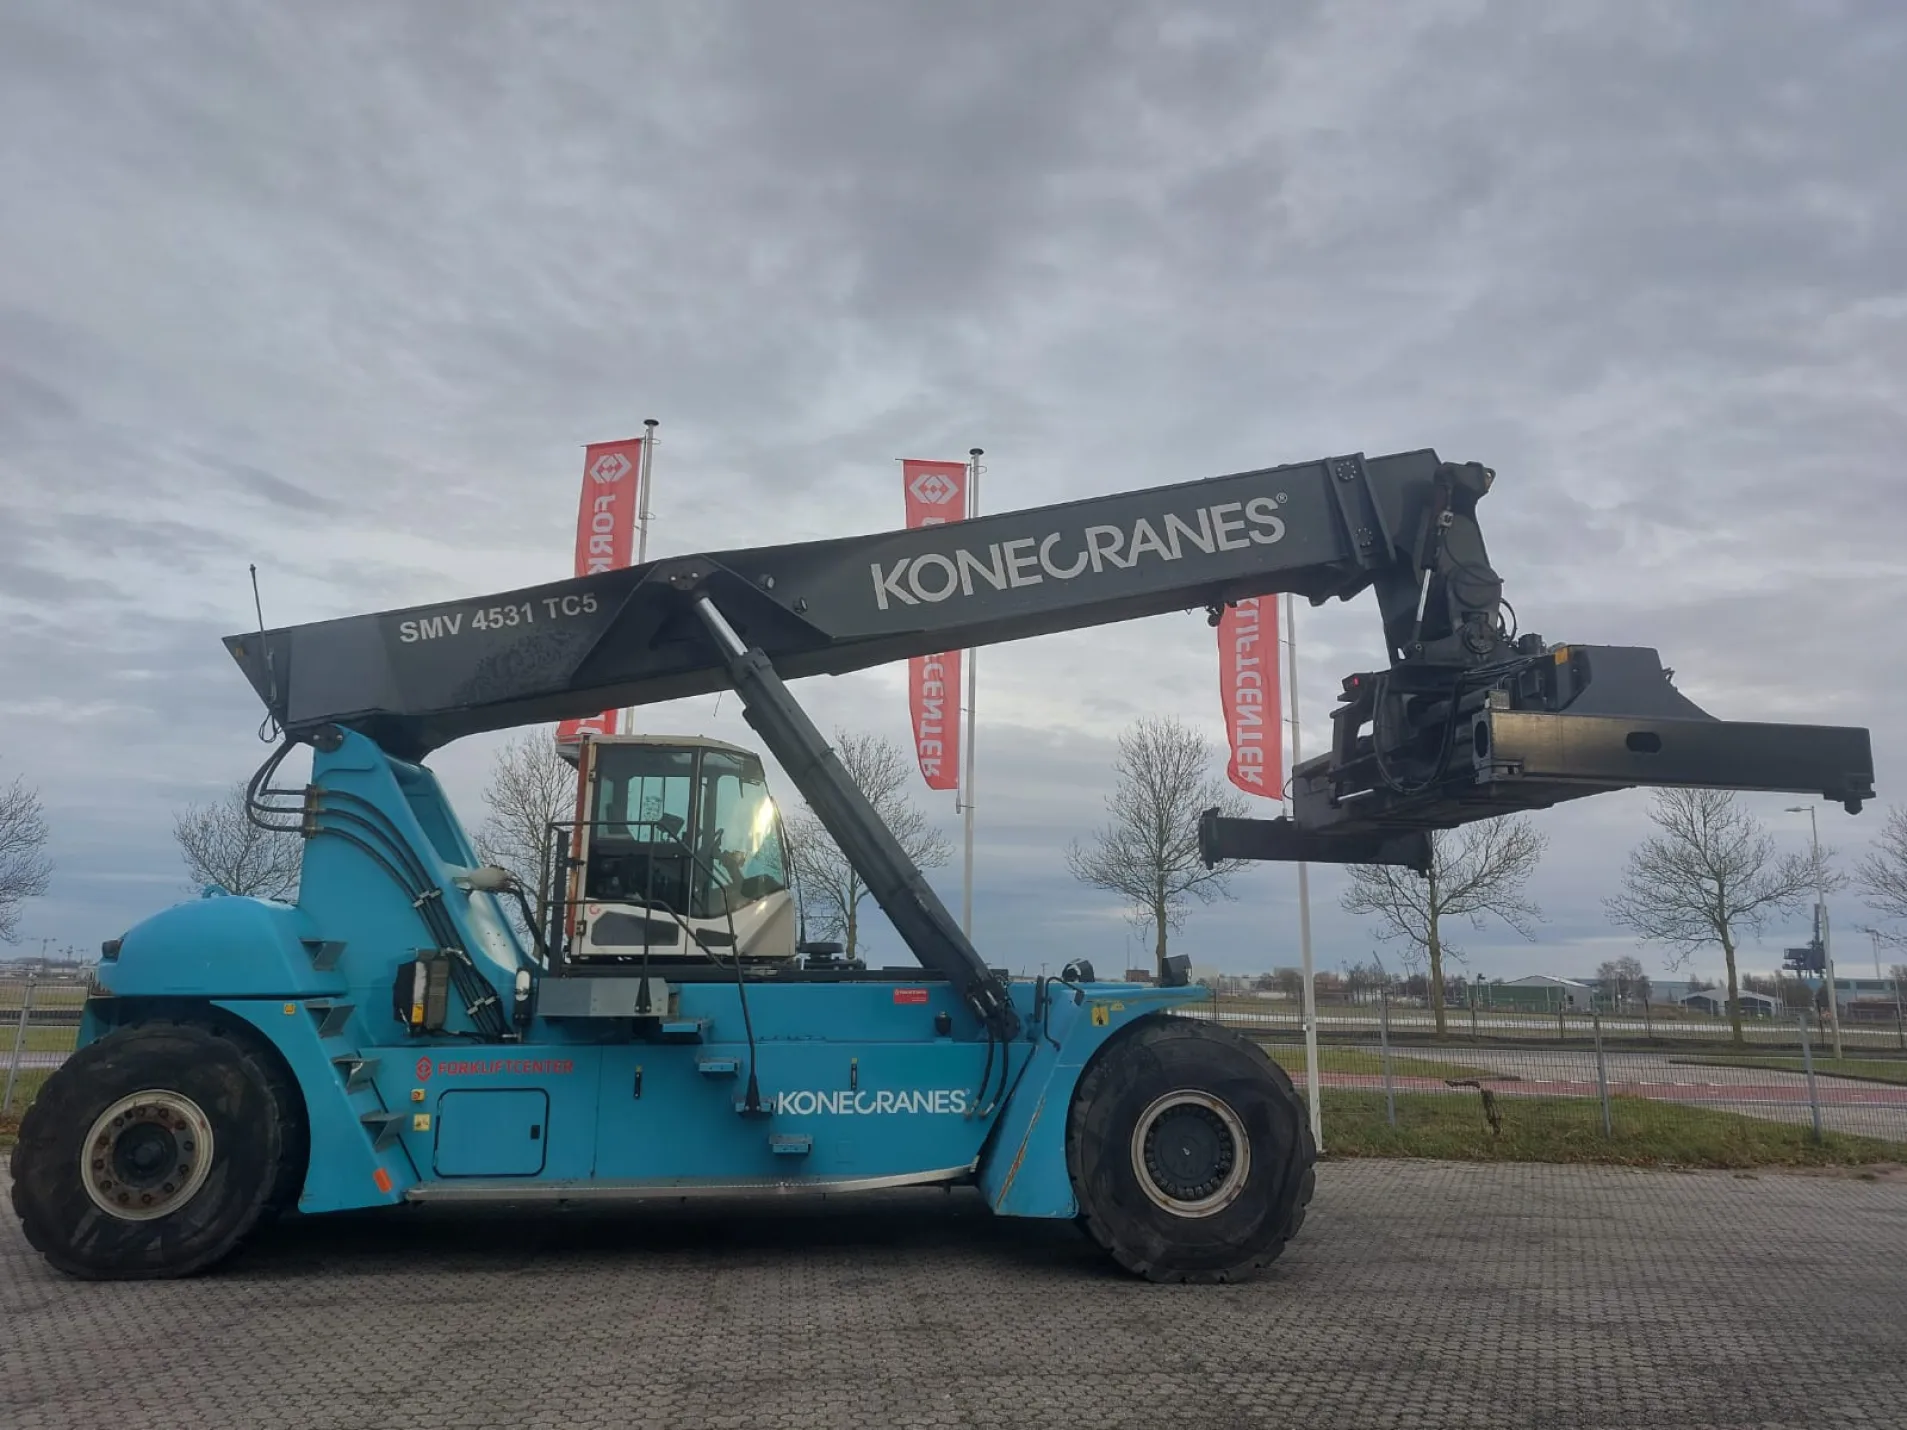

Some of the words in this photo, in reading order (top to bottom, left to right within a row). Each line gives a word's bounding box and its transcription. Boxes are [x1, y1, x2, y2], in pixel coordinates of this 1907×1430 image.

[400, 613, 463, 643] SMV
[471, 602, 534, 630] 4531
[542, 592, 598, 619] TC5
[438, 1059, 573, 1075] FORKLIFTCENTER
[777, 1089, 967, 1115] KONECRANES
